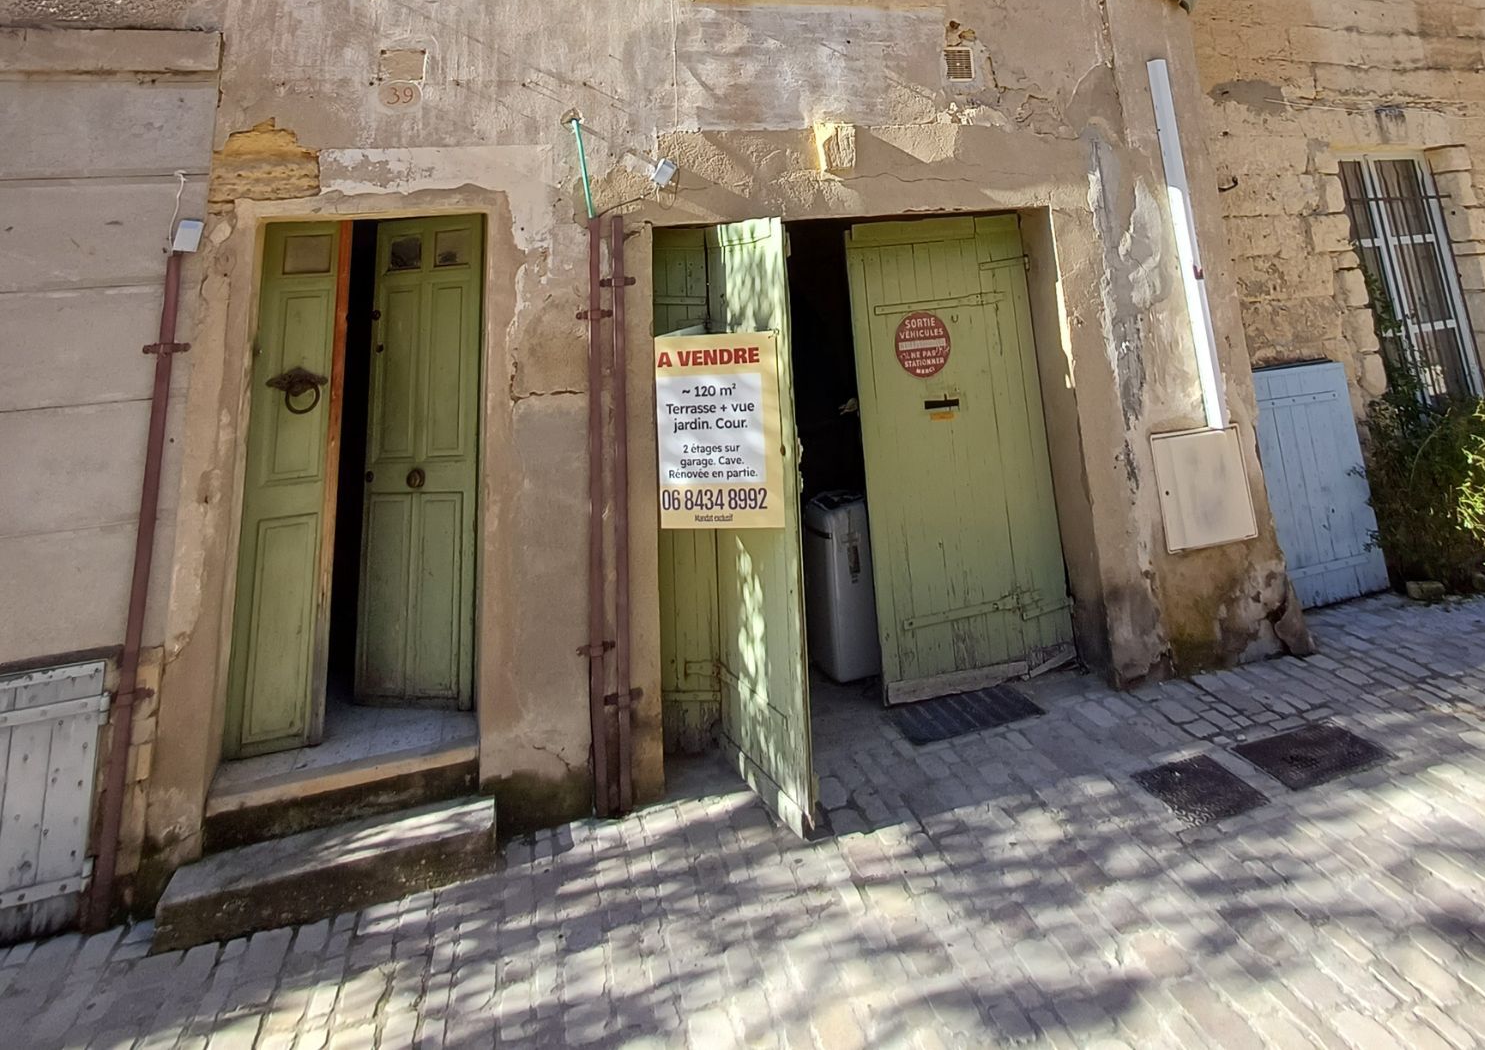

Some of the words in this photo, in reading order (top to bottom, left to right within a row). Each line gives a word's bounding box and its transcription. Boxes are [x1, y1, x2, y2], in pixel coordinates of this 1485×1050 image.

[386, 87, 414, 105] 39
[904, 317, 935, 328] SORTIE
[657, 352, 672, 368] A
[677, 347, 760, 367] VENDRE
[904, 357, 944, 367] STATIONNER
[694, 385, 716, 397] 120
[666, 404, 717, 415] Terrasse
[731, 402, 755, 412] vue
[673, 418, 712, 433] jardin.
[715, 417, 748, 430] Cour.
[683, 444, 689, 454] 2
[690, 443, 723, 456] étages
[724, 444, 741, 453] sur
[680, 457, 717, 469] garage.
[718, 455, 745, 466] Cave.
[668, 468, 710, 479] Rénovée
[711, 470, 724, 479] en
[726, 467, 759, 481] partie.
[662, 490, 682, 511] 06
[684, 488, 725, 511] 8434
[728, 488, 767, 510] 8992
